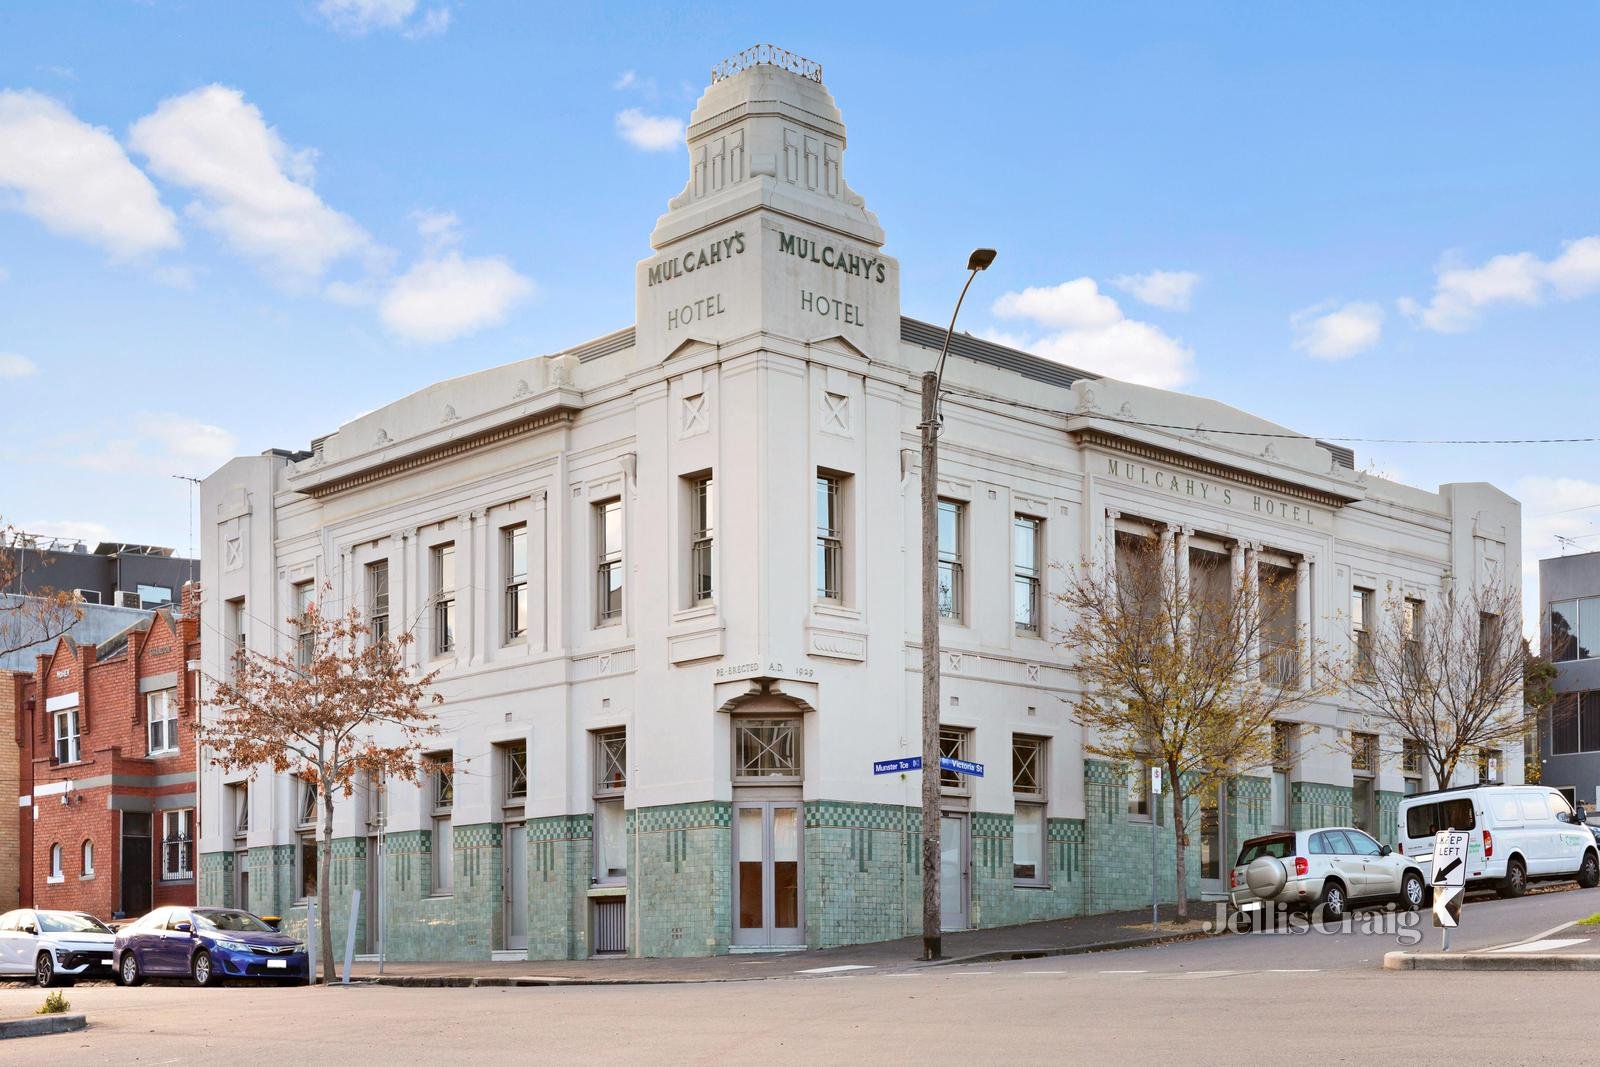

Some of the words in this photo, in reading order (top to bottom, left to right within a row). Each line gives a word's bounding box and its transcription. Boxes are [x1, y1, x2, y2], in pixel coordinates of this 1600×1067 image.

[648, 231, 745, 287] MULCAHY'S
[778, 231, 886, 283] MULCAHY'S
[667, 293, 725, 330] HOTEL
[801, 290, 864, 327] HOTEL
[1108, 459, 1232, 505] MULCAHY'S
[1253, 495, 1314, 525] HOTEL
[875, 763, 898, 773] Munster
[899, 761, 909, 770] Tce
[951, 760, 975, 772] Victoria
[975, 764, 983, 774] St
[1439, 847, 1460, 856] LEFT
